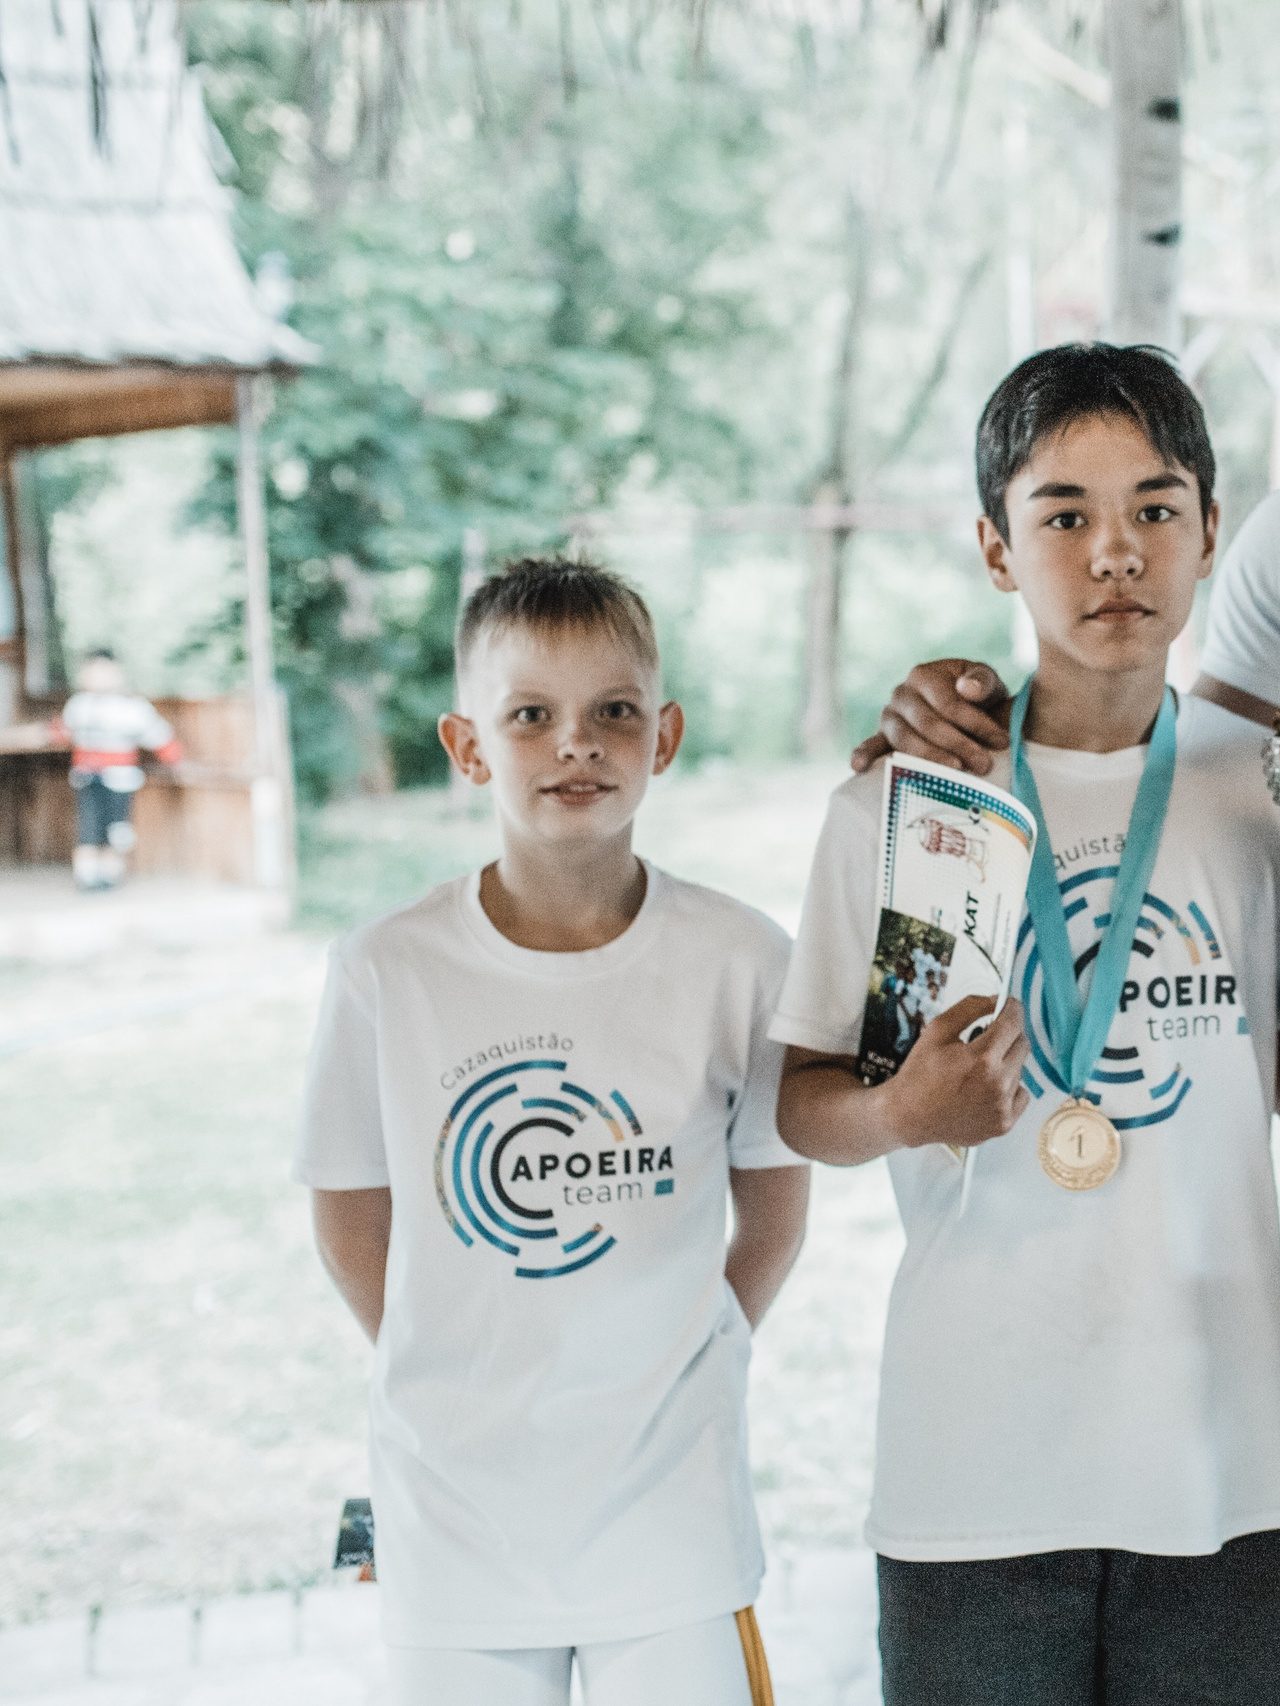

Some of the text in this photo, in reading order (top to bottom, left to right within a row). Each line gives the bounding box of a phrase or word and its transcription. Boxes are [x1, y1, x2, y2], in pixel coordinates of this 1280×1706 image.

[1054, 833, 1127, 870] quistã
[1147, 1014, 1221, 1041] team
[440, 1032, 574, 1091] Cazaquistão
[562, 1181, 643, 1206] team
